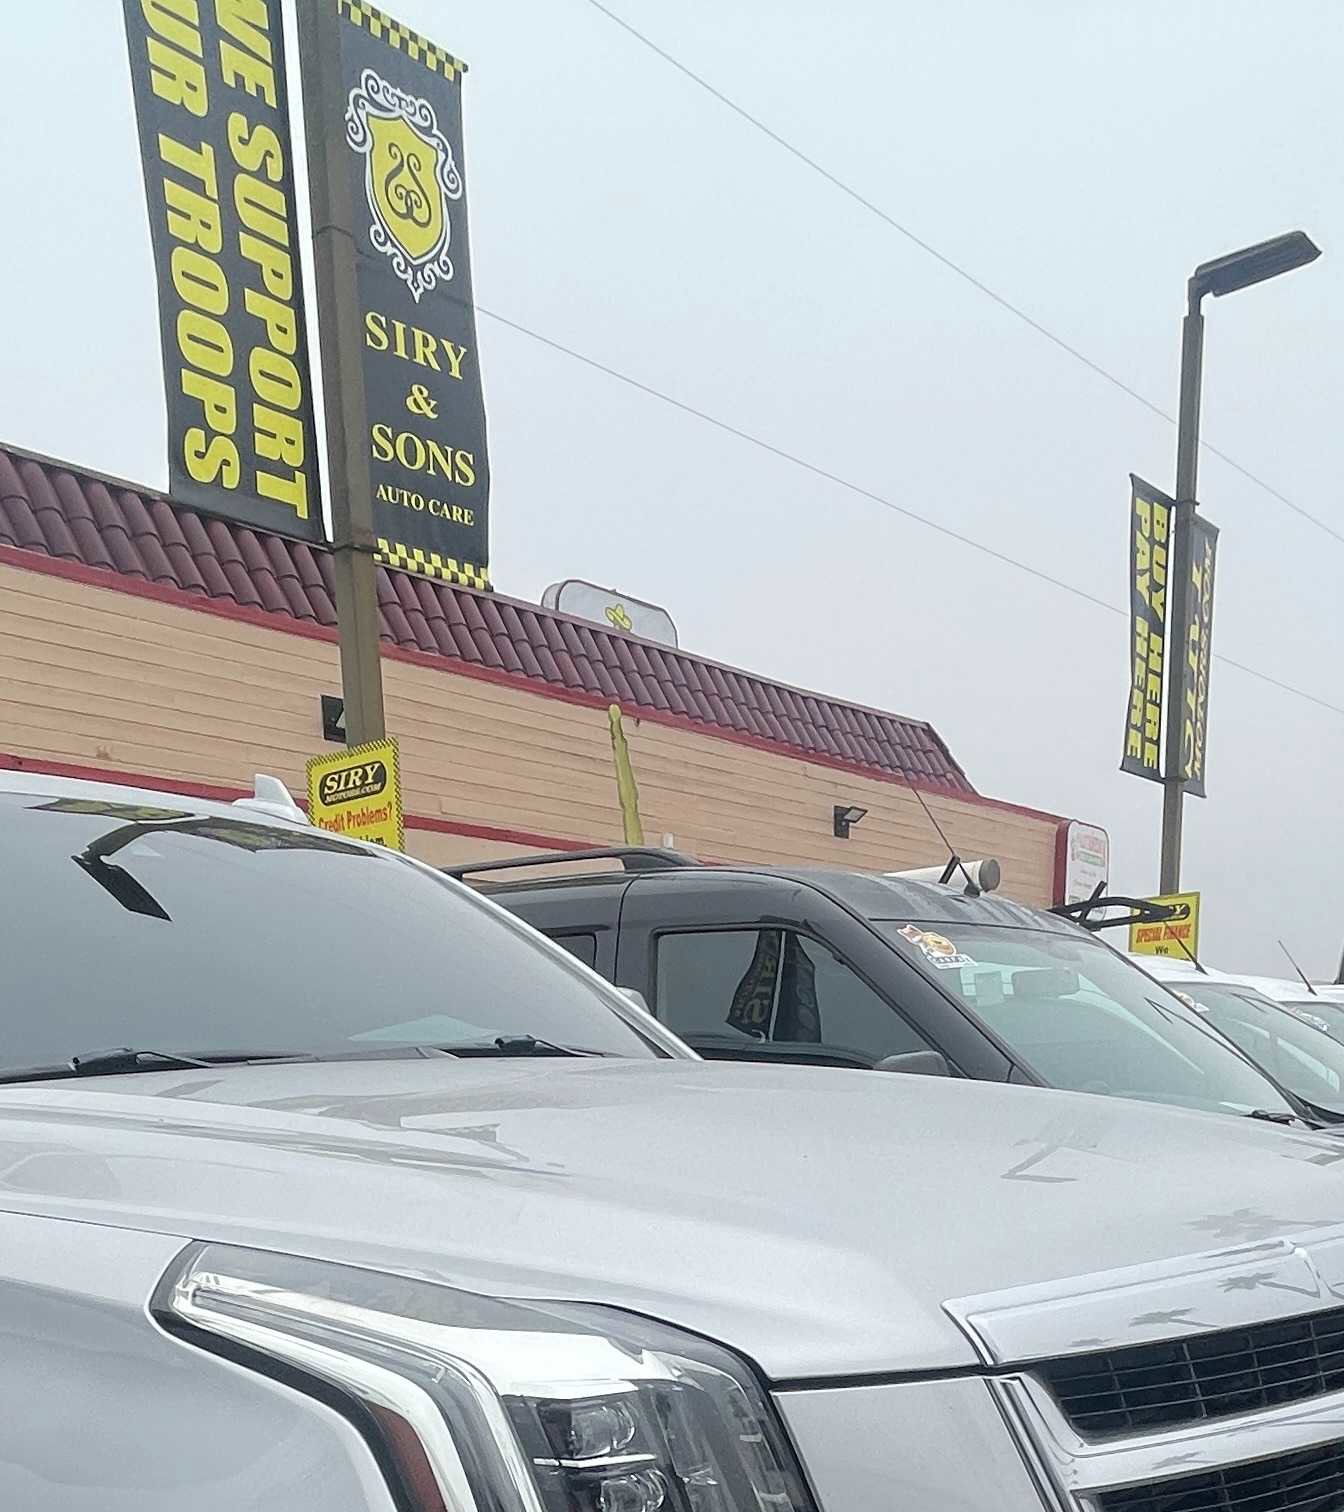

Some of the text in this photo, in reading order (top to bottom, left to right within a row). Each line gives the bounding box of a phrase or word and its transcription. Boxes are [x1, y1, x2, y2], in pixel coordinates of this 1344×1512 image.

[158, 132, 241, 491] TROOPS
[227, 111, 309, 520] SUPPORT
[365, 311, 468, 380] SIRY
[406, 384, 439, 419] &
[371, 423, 476, 487] SONS
[376, 483, 475, 526] AUTO CARE
[1128, 497, 1151, 757] PAY HERE
[1143, 502, 1168, 769] BUY HERE
[324, 763, 381, 794] SIRY
[346, 801, 393, 830] Problems?
